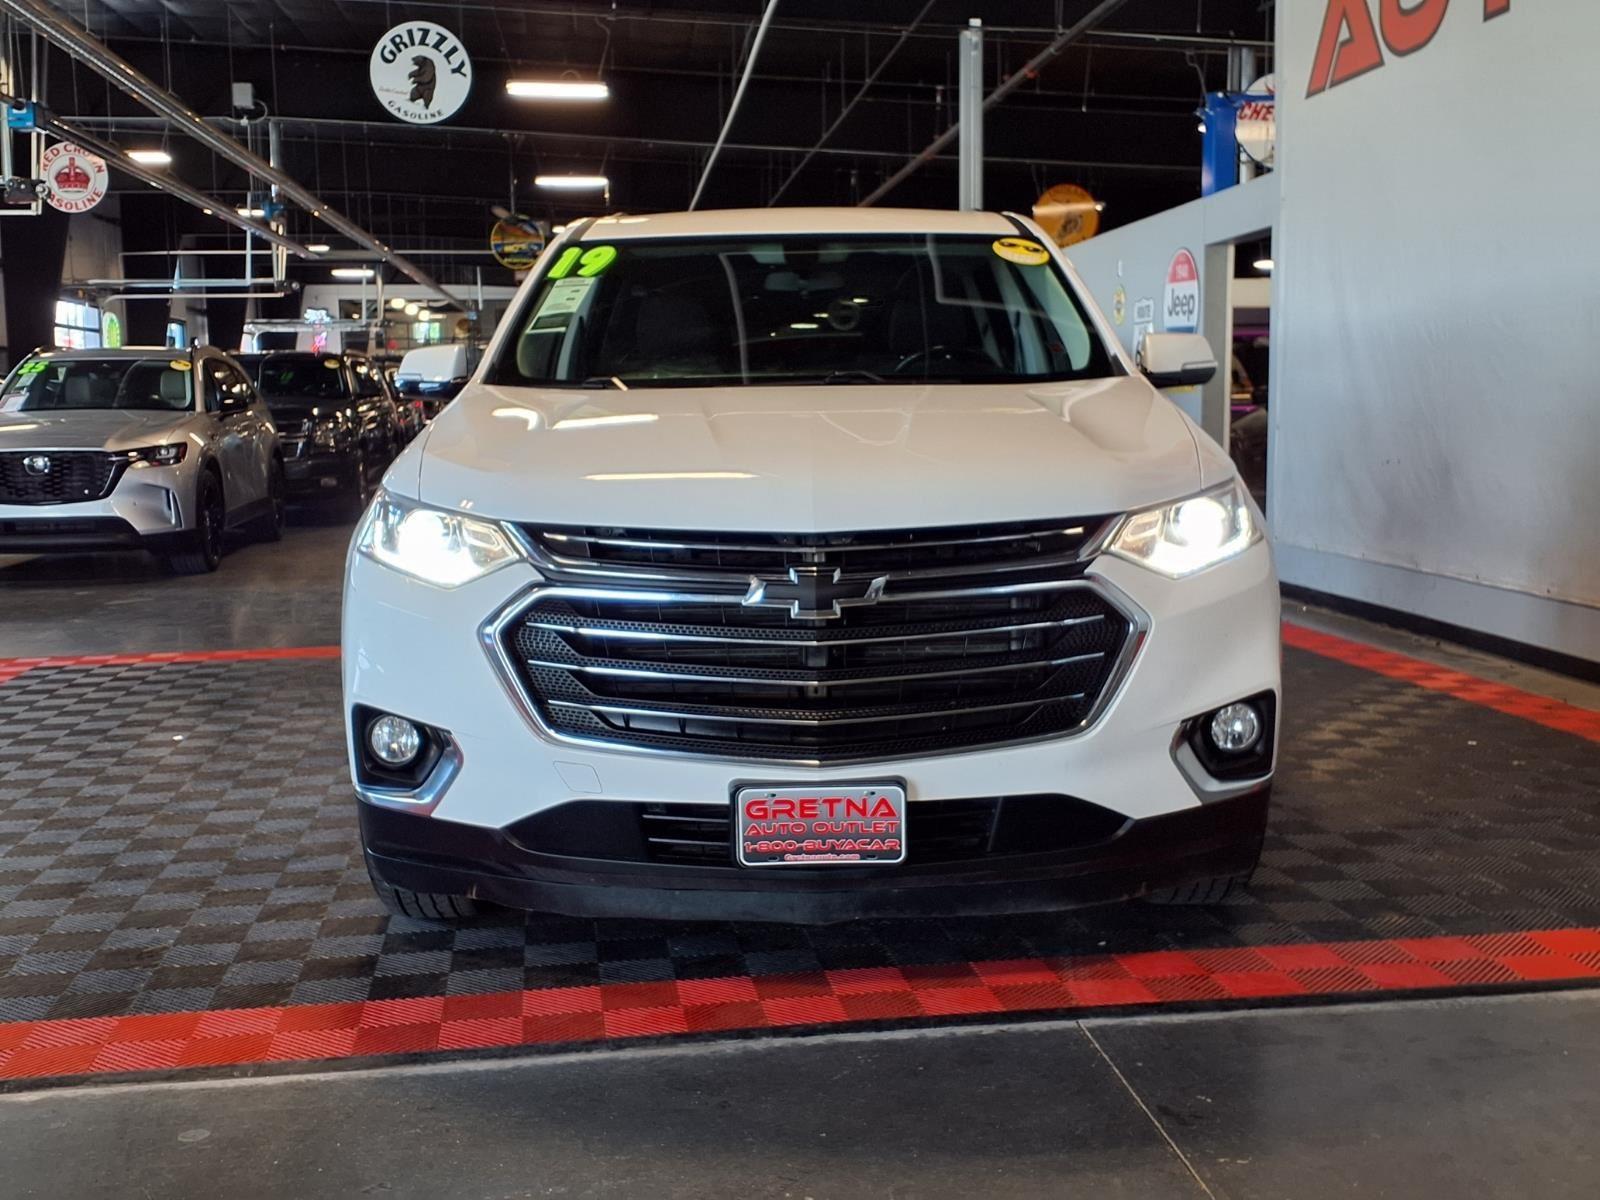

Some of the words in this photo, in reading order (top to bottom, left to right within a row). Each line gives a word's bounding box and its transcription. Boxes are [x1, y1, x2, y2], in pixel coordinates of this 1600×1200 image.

[380, 27, 467, 78] GRIZZLY
[387, 100, 444, 120] GASOLINE
[50, 187, 103, 211] ASOLINE
[547, 245, 618, 279] 19
[1167, 288, 1195, 322] Jeep
[745, 797, 898, 820] GRETNA
[744, 822, 807, 836] AUTO
[812, 820, 900, 835] OUTLET
[744, 838, 901, 853] 1-800-BUYACAR
